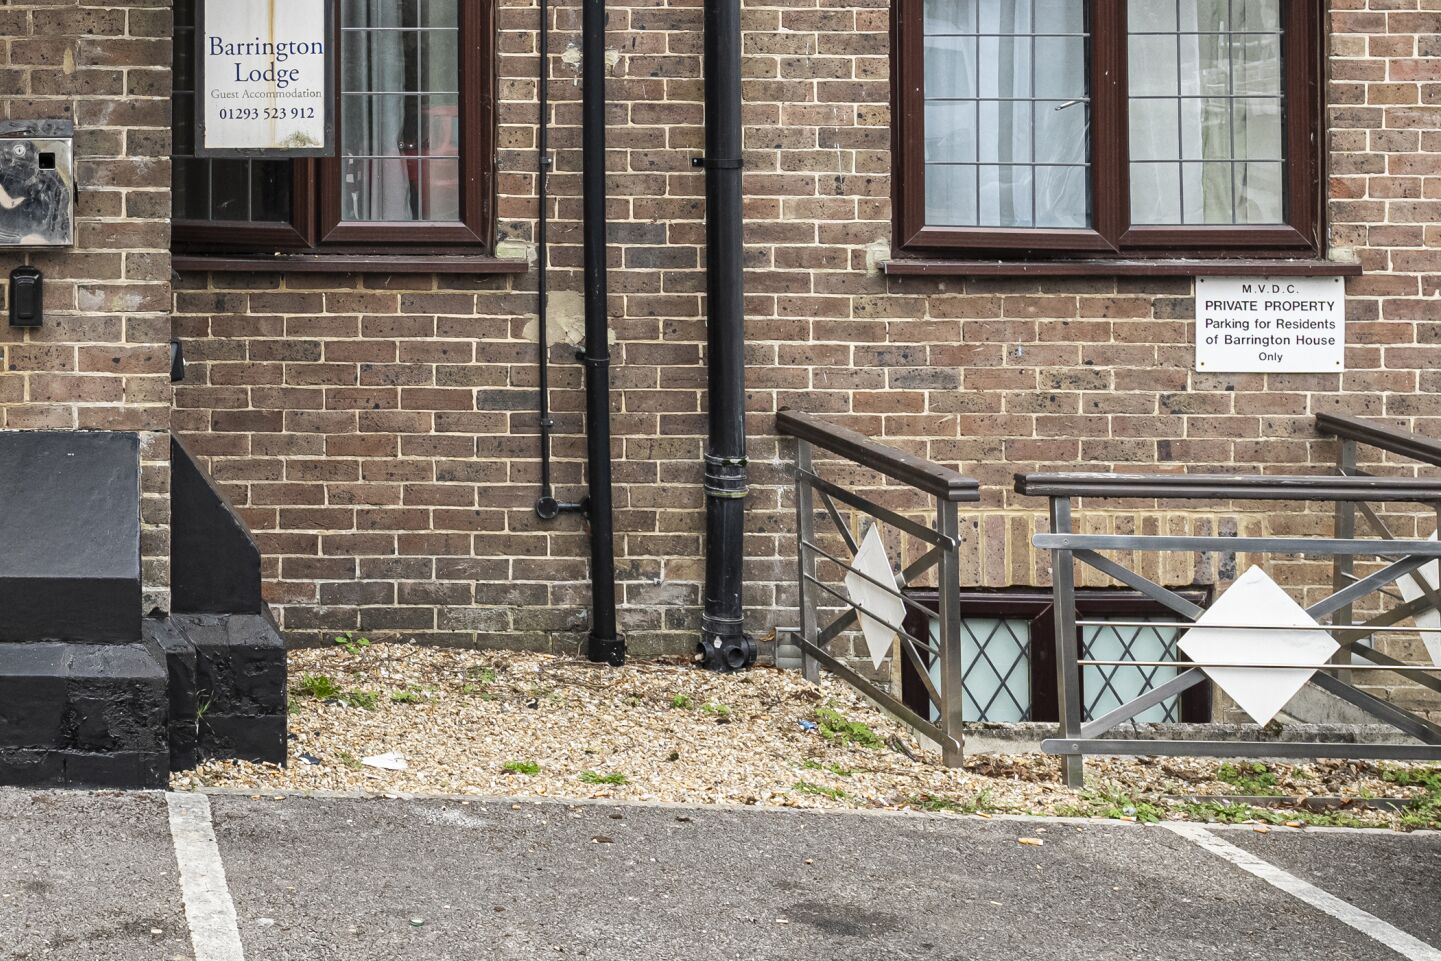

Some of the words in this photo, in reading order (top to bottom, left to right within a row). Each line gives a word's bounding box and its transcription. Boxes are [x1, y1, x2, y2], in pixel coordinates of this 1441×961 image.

[209, 36, 324, 62] Barrington
[234, 61, 300, 89] Lodge
[210, 89, 239, 99] Guest
[242, 88, 322, 99] Accommodation
[219, 108, 259, 120] 01293
[263, 107, 287, 120] 523
[290, 107, 315, 120] 912
[1242, 284, 1300, 294] M.V.D.C.
[1205, 300, 1258, 311] PRIVATE
[1264, 301, 1335, 311] PROPERTY
[1205, 318, 1250, 331] Parking
[1254, 318, 1271, 329] for
[1276, 318, 1336, 329] Residents
[1205, 334, 1218, 345] of
[1225, 334, 1290, 347] Barrington
[1296, 335, 1336, 345] House
[1258, 352, 1283, 363] Only
